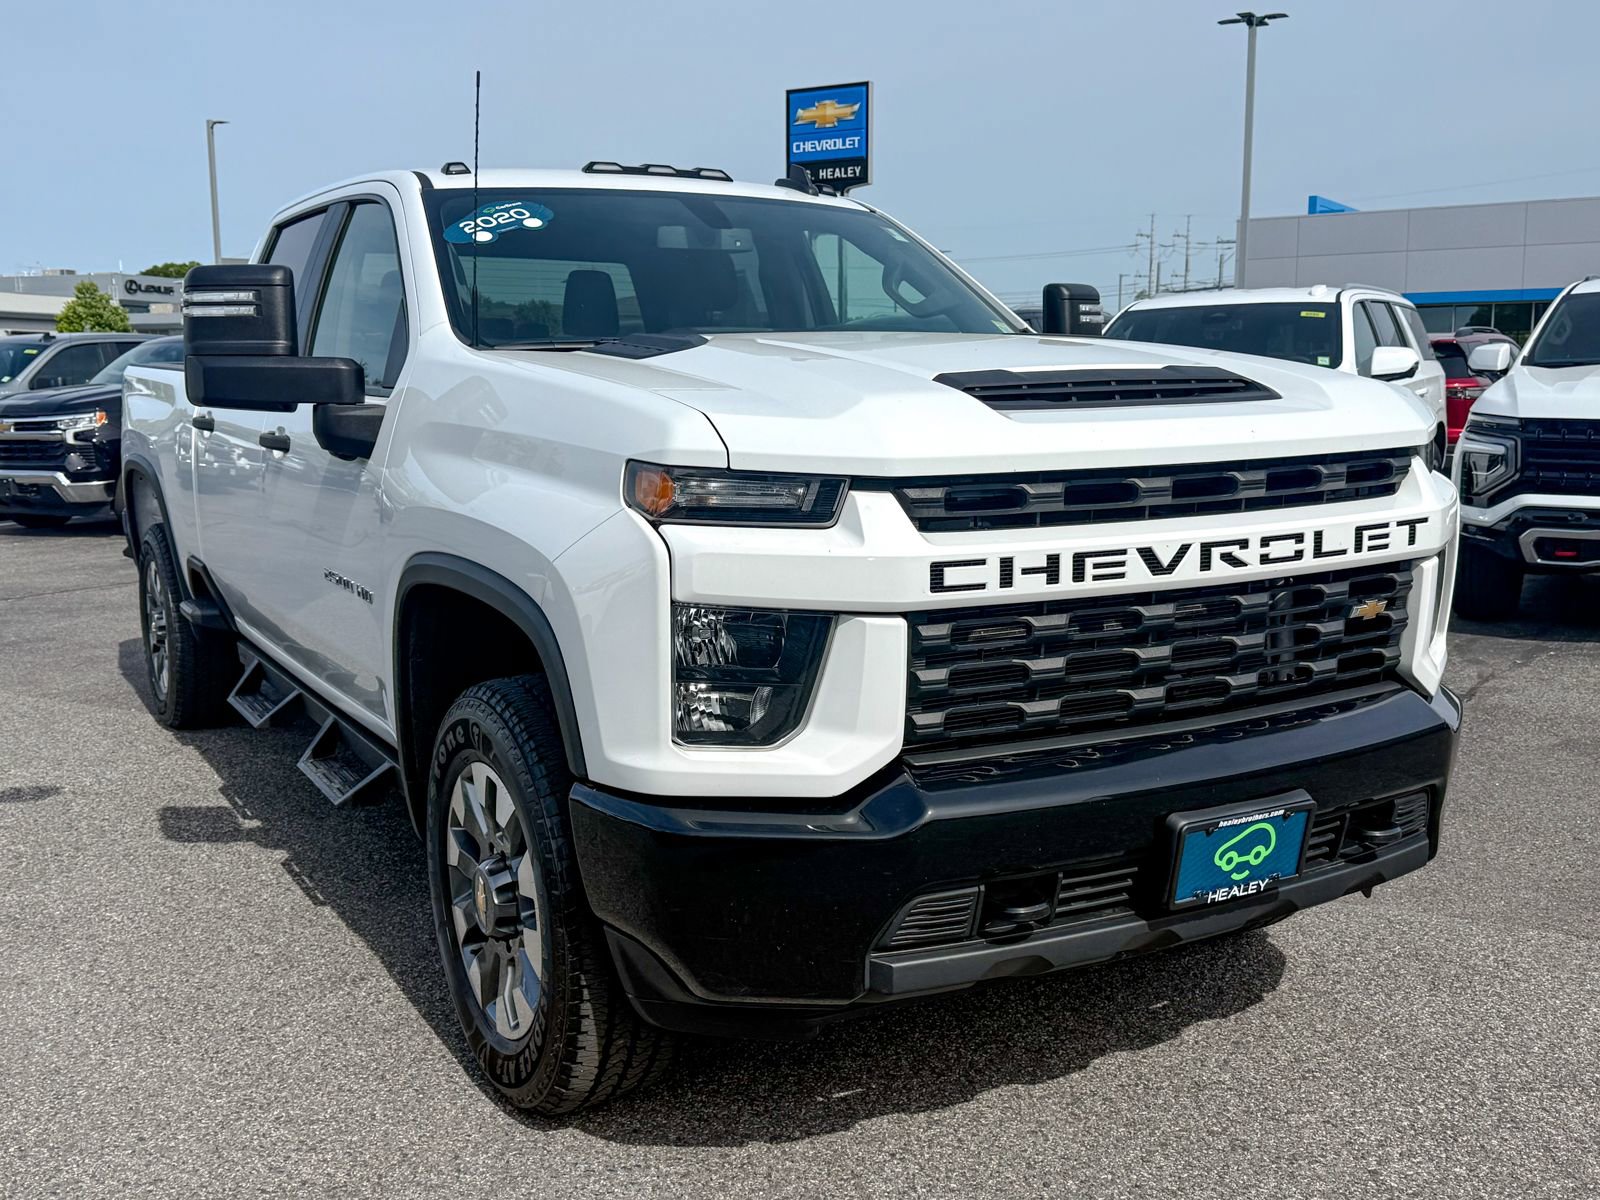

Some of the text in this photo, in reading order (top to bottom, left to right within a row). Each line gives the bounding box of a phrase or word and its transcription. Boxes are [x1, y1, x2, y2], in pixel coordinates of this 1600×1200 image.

[793, 137, 861, 153] CHEVROLET
[819, 166, 861, 180] HEALEY
[459, 208, 531, 234] 2020
[929, 517, 1429, 593] CHEVROLET
[1218, 809, 1285, 828] healeybrothers.com
[1207, 878, 1270, 904] HEALEY
